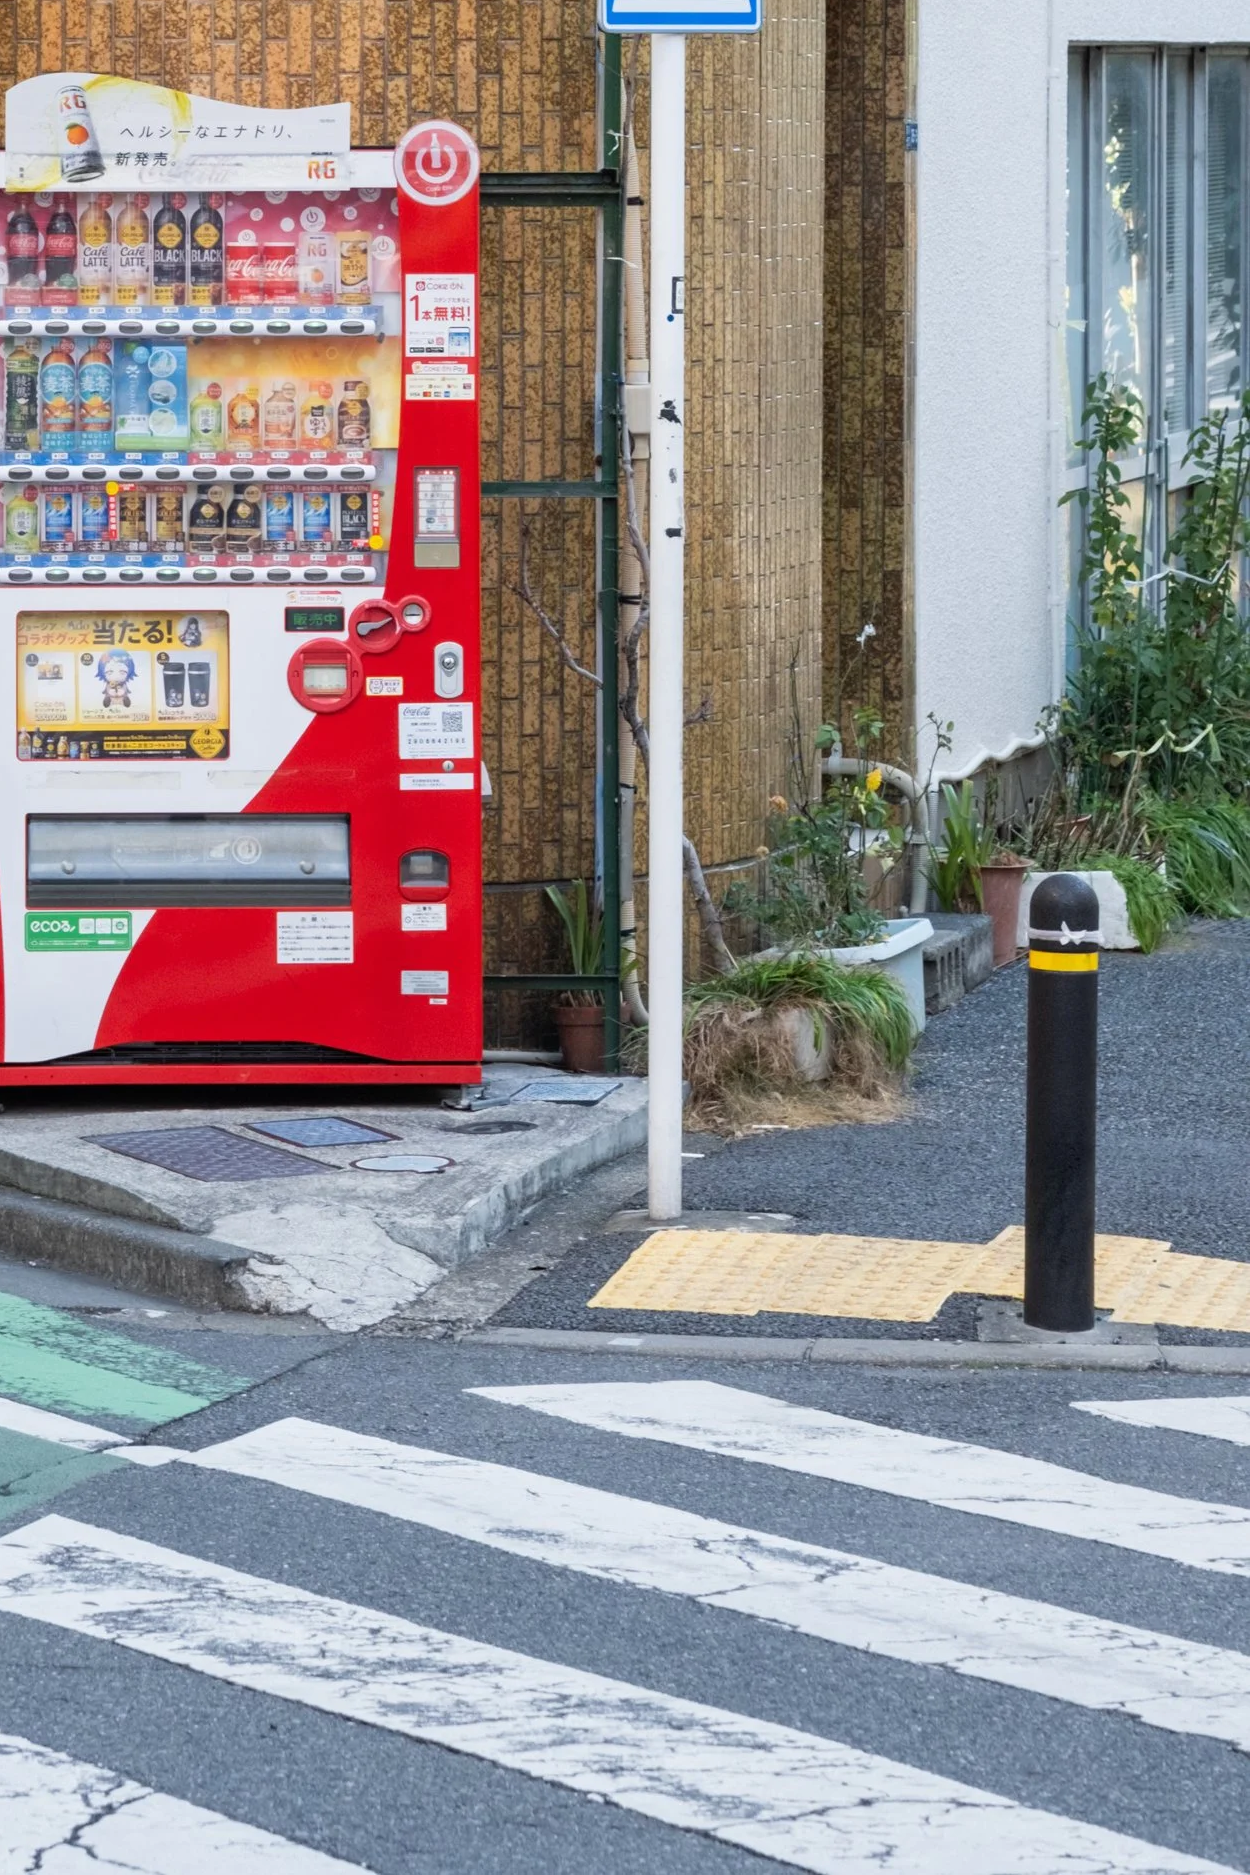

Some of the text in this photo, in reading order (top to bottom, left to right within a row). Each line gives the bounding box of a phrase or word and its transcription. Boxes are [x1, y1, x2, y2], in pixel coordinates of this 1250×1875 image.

[59, 94, 87, 112] RG
[120, 125, 293, 139] ヘルシーなエナドリ、
[115, 152, 178, 166] 新発売。
[308, 160, 336, 179] RG
[83, 246, 108, 257] Café
[120, 246, 145, 257] Café
[154, 250, 185, 262] BLACK
[191, 250, 222, 262] BLACK
[83, 257, 108, 267] LATTE
[120, 257, 145, 267] LATTE
[293, 613, 338, 626] 販売中
[92, 619, 173, 645] 当たる!
[17, 632, 91, 646] コラボグッズ
